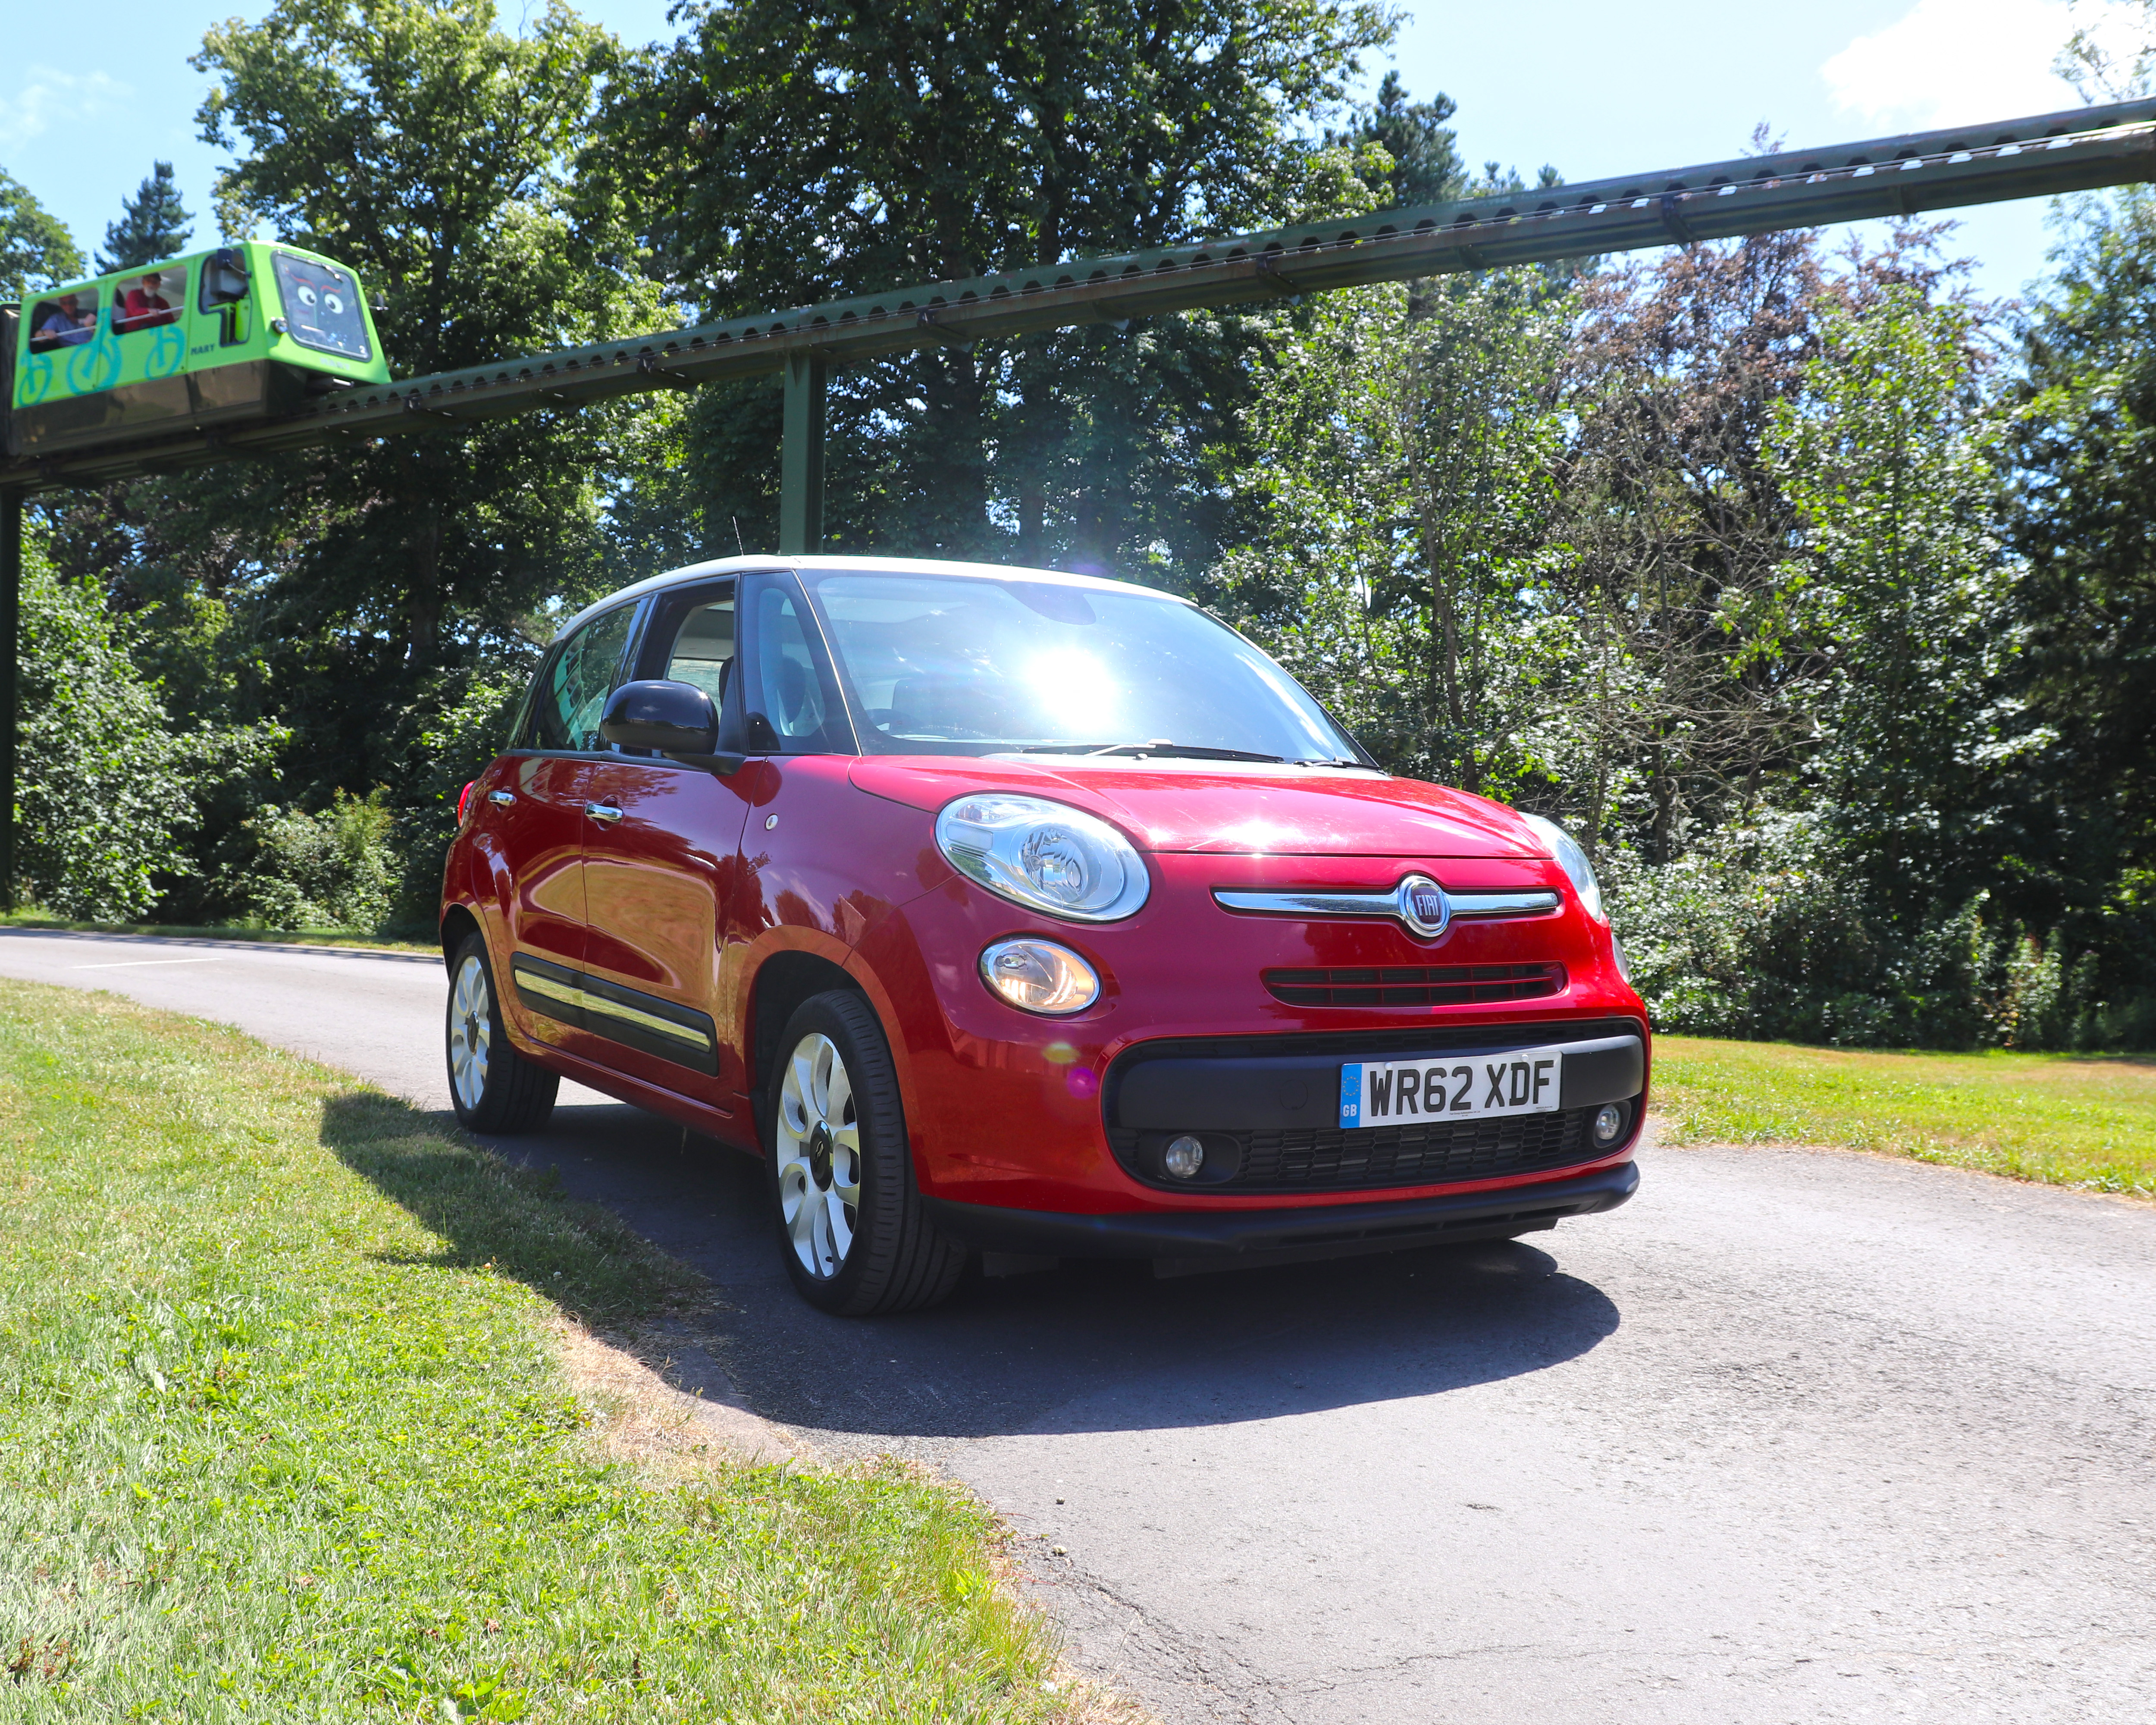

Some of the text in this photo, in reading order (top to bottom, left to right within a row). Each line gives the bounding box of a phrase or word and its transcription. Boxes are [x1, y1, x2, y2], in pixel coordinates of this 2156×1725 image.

[190, 343, 215, 355] MARY
[359, 345, 365, 354] 2
[1415, 895, 1439, 916] FIAT
[1370, 1060, 1554, 1117] WR62 XDF
[1343, 1104, 1357, 1117] GB
